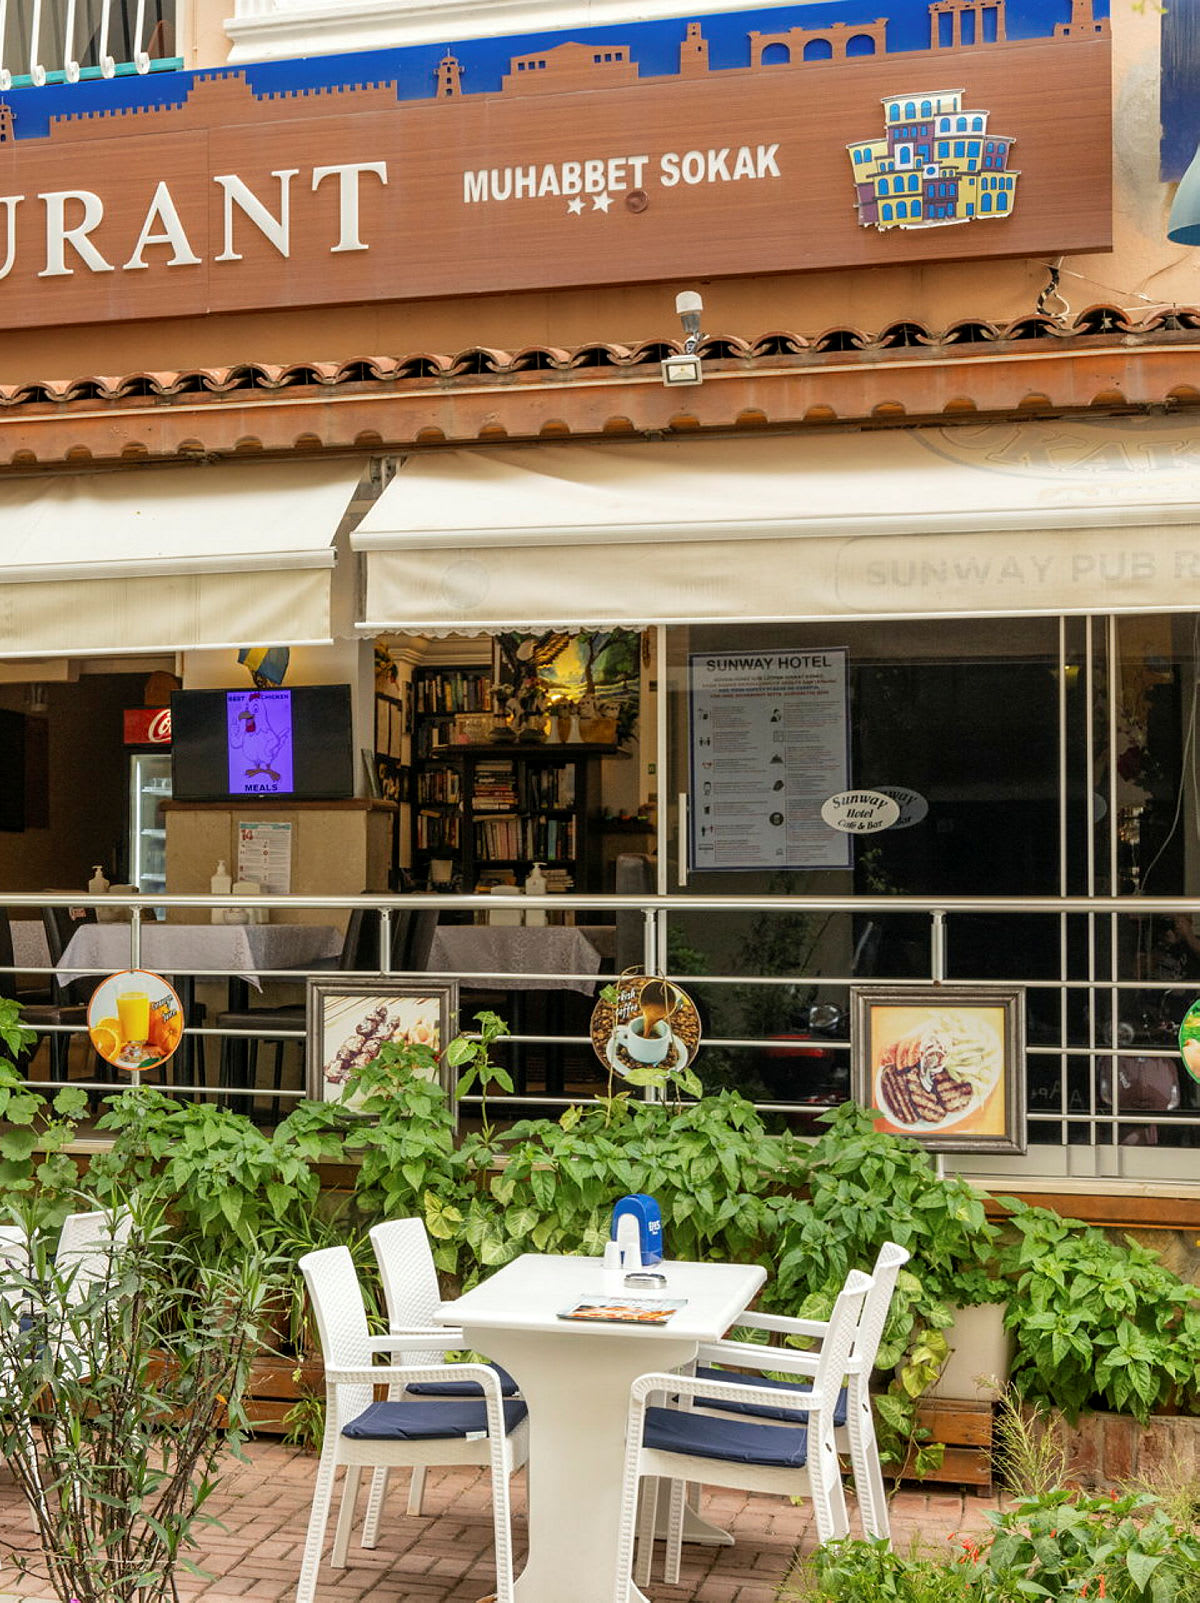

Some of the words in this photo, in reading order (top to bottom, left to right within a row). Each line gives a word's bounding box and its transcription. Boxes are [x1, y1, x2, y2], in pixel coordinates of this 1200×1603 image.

[463, 155, 649, 203] MUHABBET
[660, 144, 781, 187] SOKAK
[866, 554, 1057, 588] SUNWAY
[1072, 551, 1158, 582] PUB
[706, 657, 774, 672] SUNWAY
[778, 655, 831, 669] HOTEL
[244, 784, 278, 792] MEALS
[832, 794, 888, 810] Sunway
[846, 809, 874, 819] Hotel
[866, 821, 883, 830] Bar
